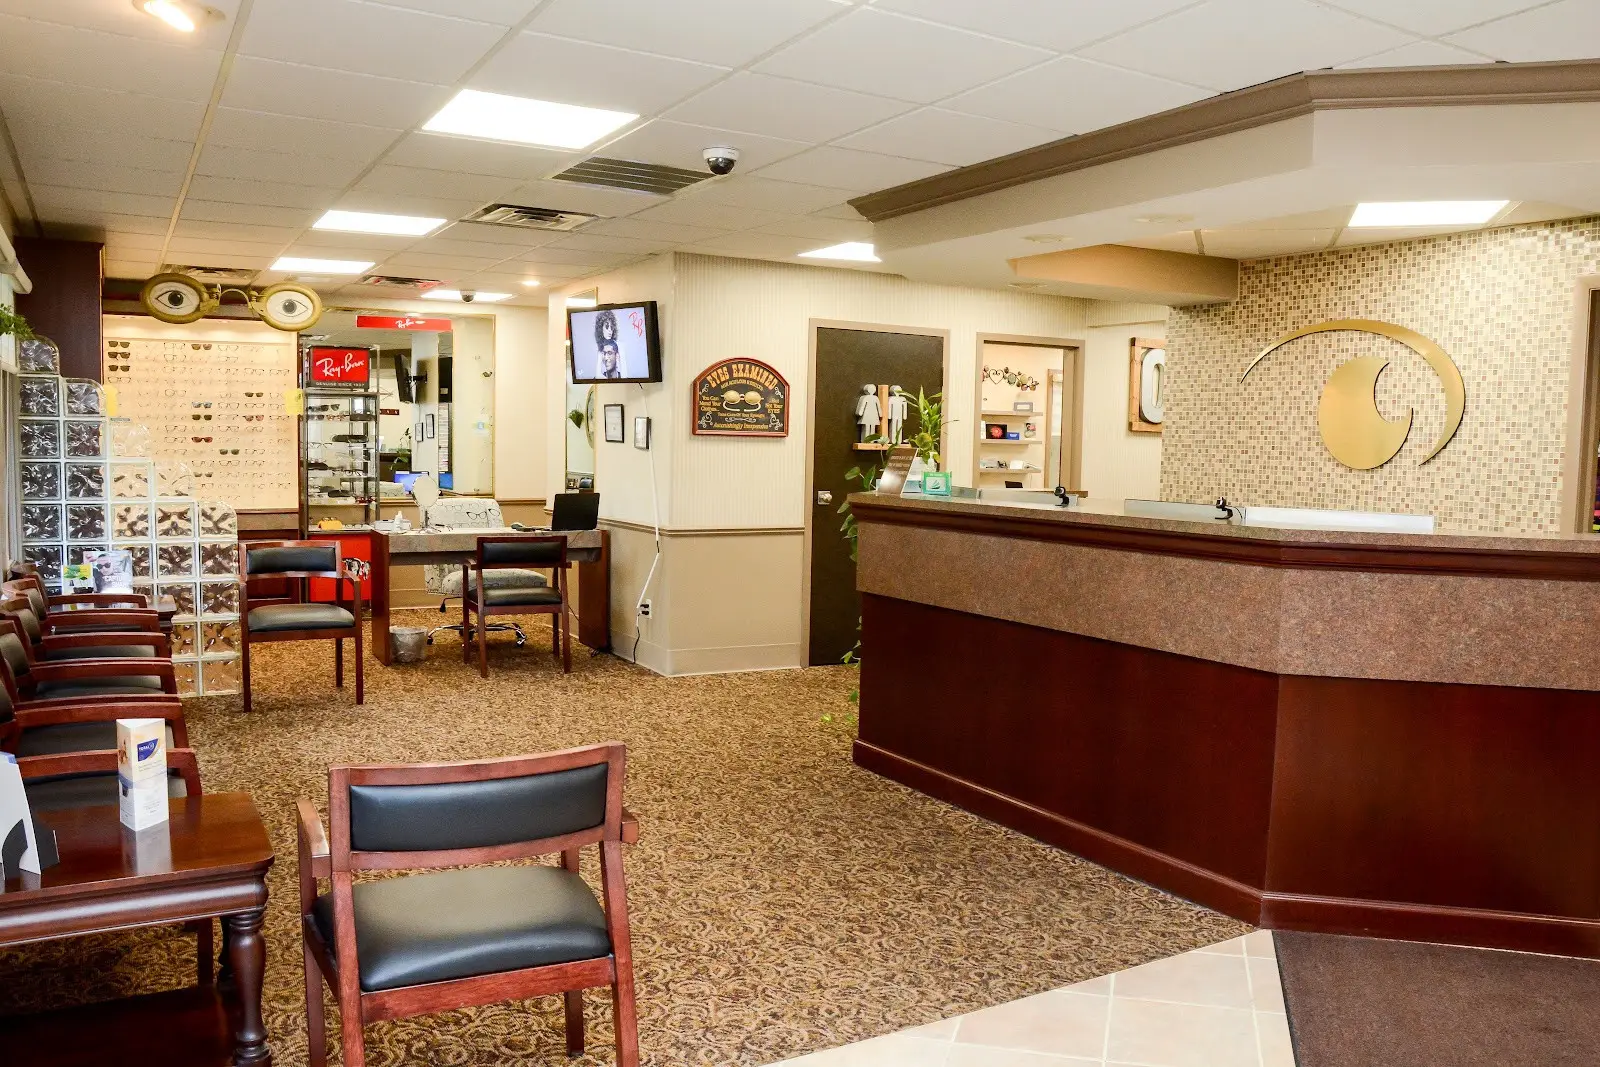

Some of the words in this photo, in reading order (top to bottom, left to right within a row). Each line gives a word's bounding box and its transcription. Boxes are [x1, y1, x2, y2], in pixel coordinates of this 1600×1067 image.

[316, 353, 365, 377] Ray-Ban
[706, 366, 729, 388] EYES
[732, 364, 778, 390] EXAMINED
